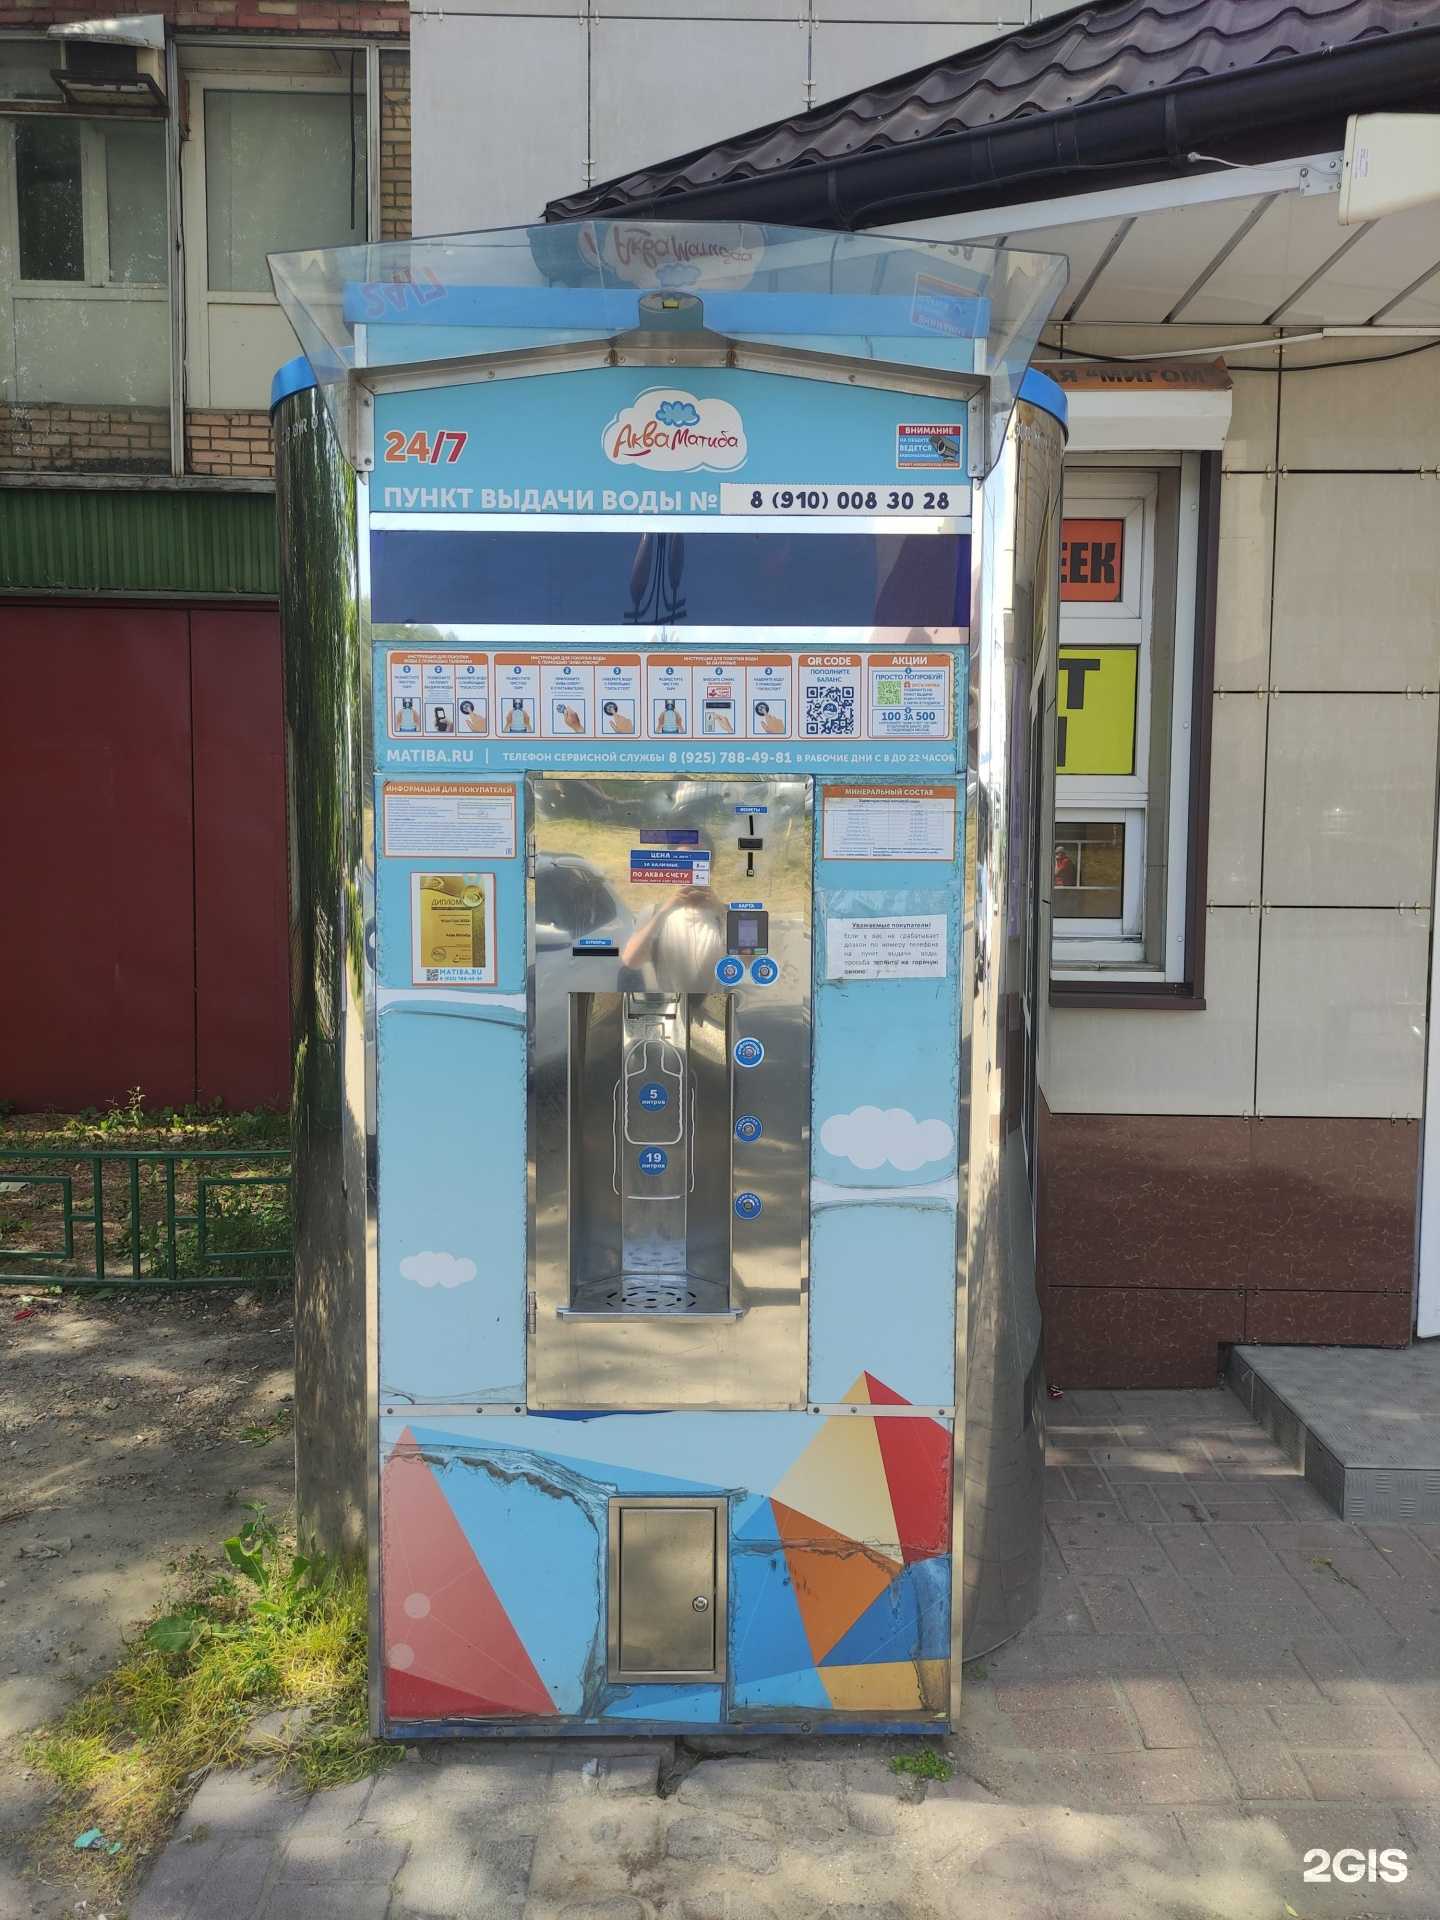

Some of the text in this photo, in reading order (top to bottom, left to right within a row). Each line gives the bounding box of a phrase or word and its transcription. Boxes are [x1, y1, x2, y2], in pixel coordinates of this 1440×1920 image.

[905, 426, 953, 435] ВНИМАНИЕ
[384, 430, 468, 465] 24/7
[899, 444, 932, 452] ВЕДЕТСЯ
[384, 487, 718, 514] ПУНКТ ВЫДАЧИ ВОДЫ №
[750, 491, 950, 510] 8 (910) 008 30 28
[808, 656, 852, 666] QR CODE
[892, 656, 928, 666] АКЦИИ
[881, 712, 936, 721] 100 ЗА 500
[387, 750, 474, 762] MATIBA.RU
[503, 752, 552, 761] ТЕЛЕФОН
[554, 752, 617, 762] СЕРВИСНОЙ
[619, 752, 665, 763] СЛУЖБЫ
[669, 752, 677, 763] 8
[681, 752, 716, 764] (925)
[719, 752, 792, 764] 788-49-81
[804, 754, 849, 762] РАБОЧИЕ
[851, 754, 873, 763] ДНИ
[386, 785, 440, 793] ИНФОРМАЦИЯ
[458, 785, 513, 793] ПОКУПАТЕЛЕЙ
[845, 788, 902, 796] МИНЕРАЛЬНЫЙ
[649, 1089, 657, 1099] 5
[646, 1152, 662, 1163] 19
